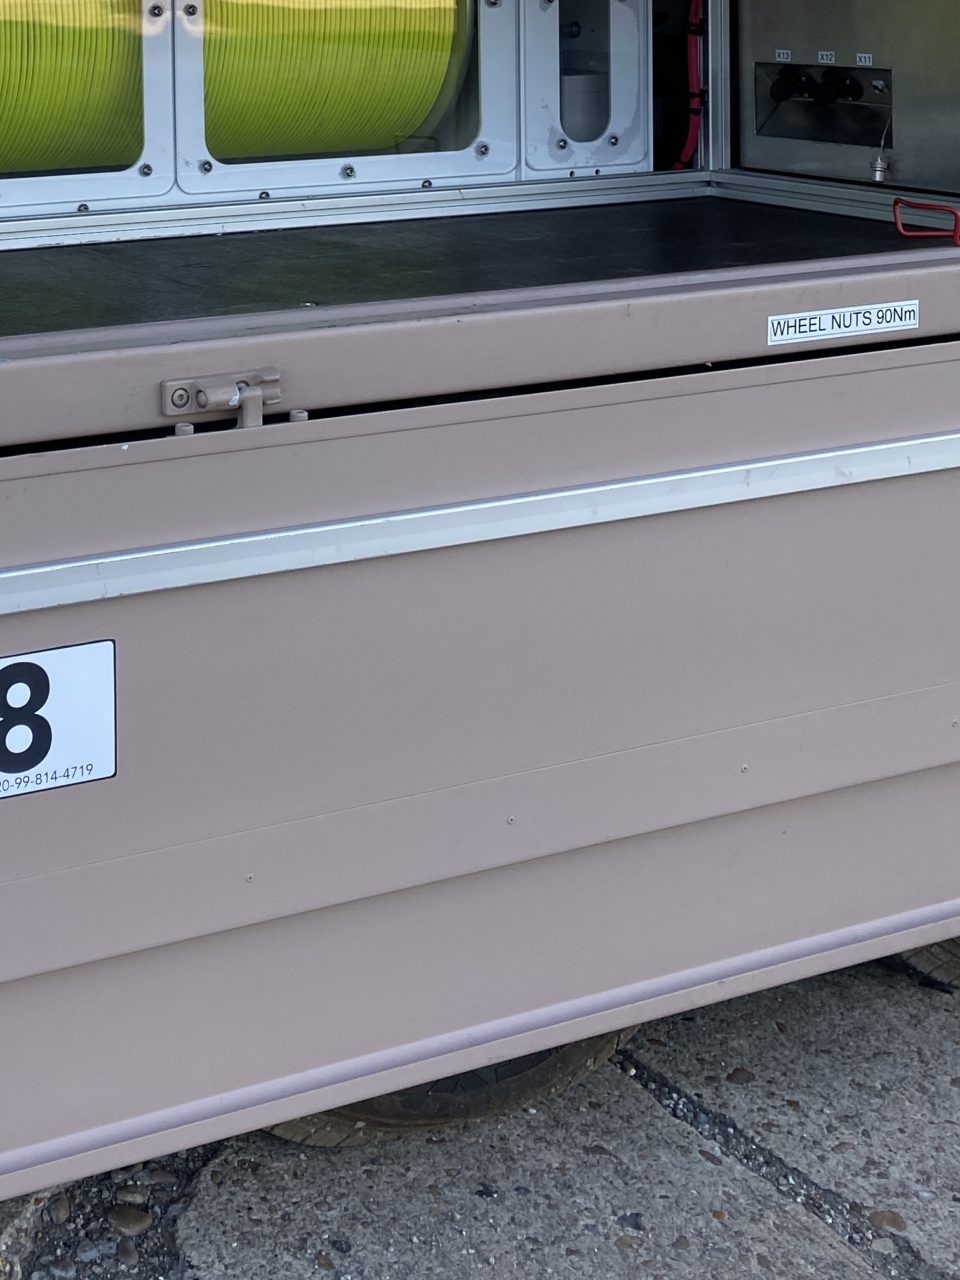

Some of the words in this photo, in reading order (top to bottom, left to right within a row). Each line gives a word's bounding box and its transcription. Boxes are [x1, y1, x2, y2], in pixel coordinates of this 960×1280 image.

[771, 316, 826, 337] WHEEL
[831, 310, 872, 330] NUTS
[876, 306, 916, 325] 90Nm
